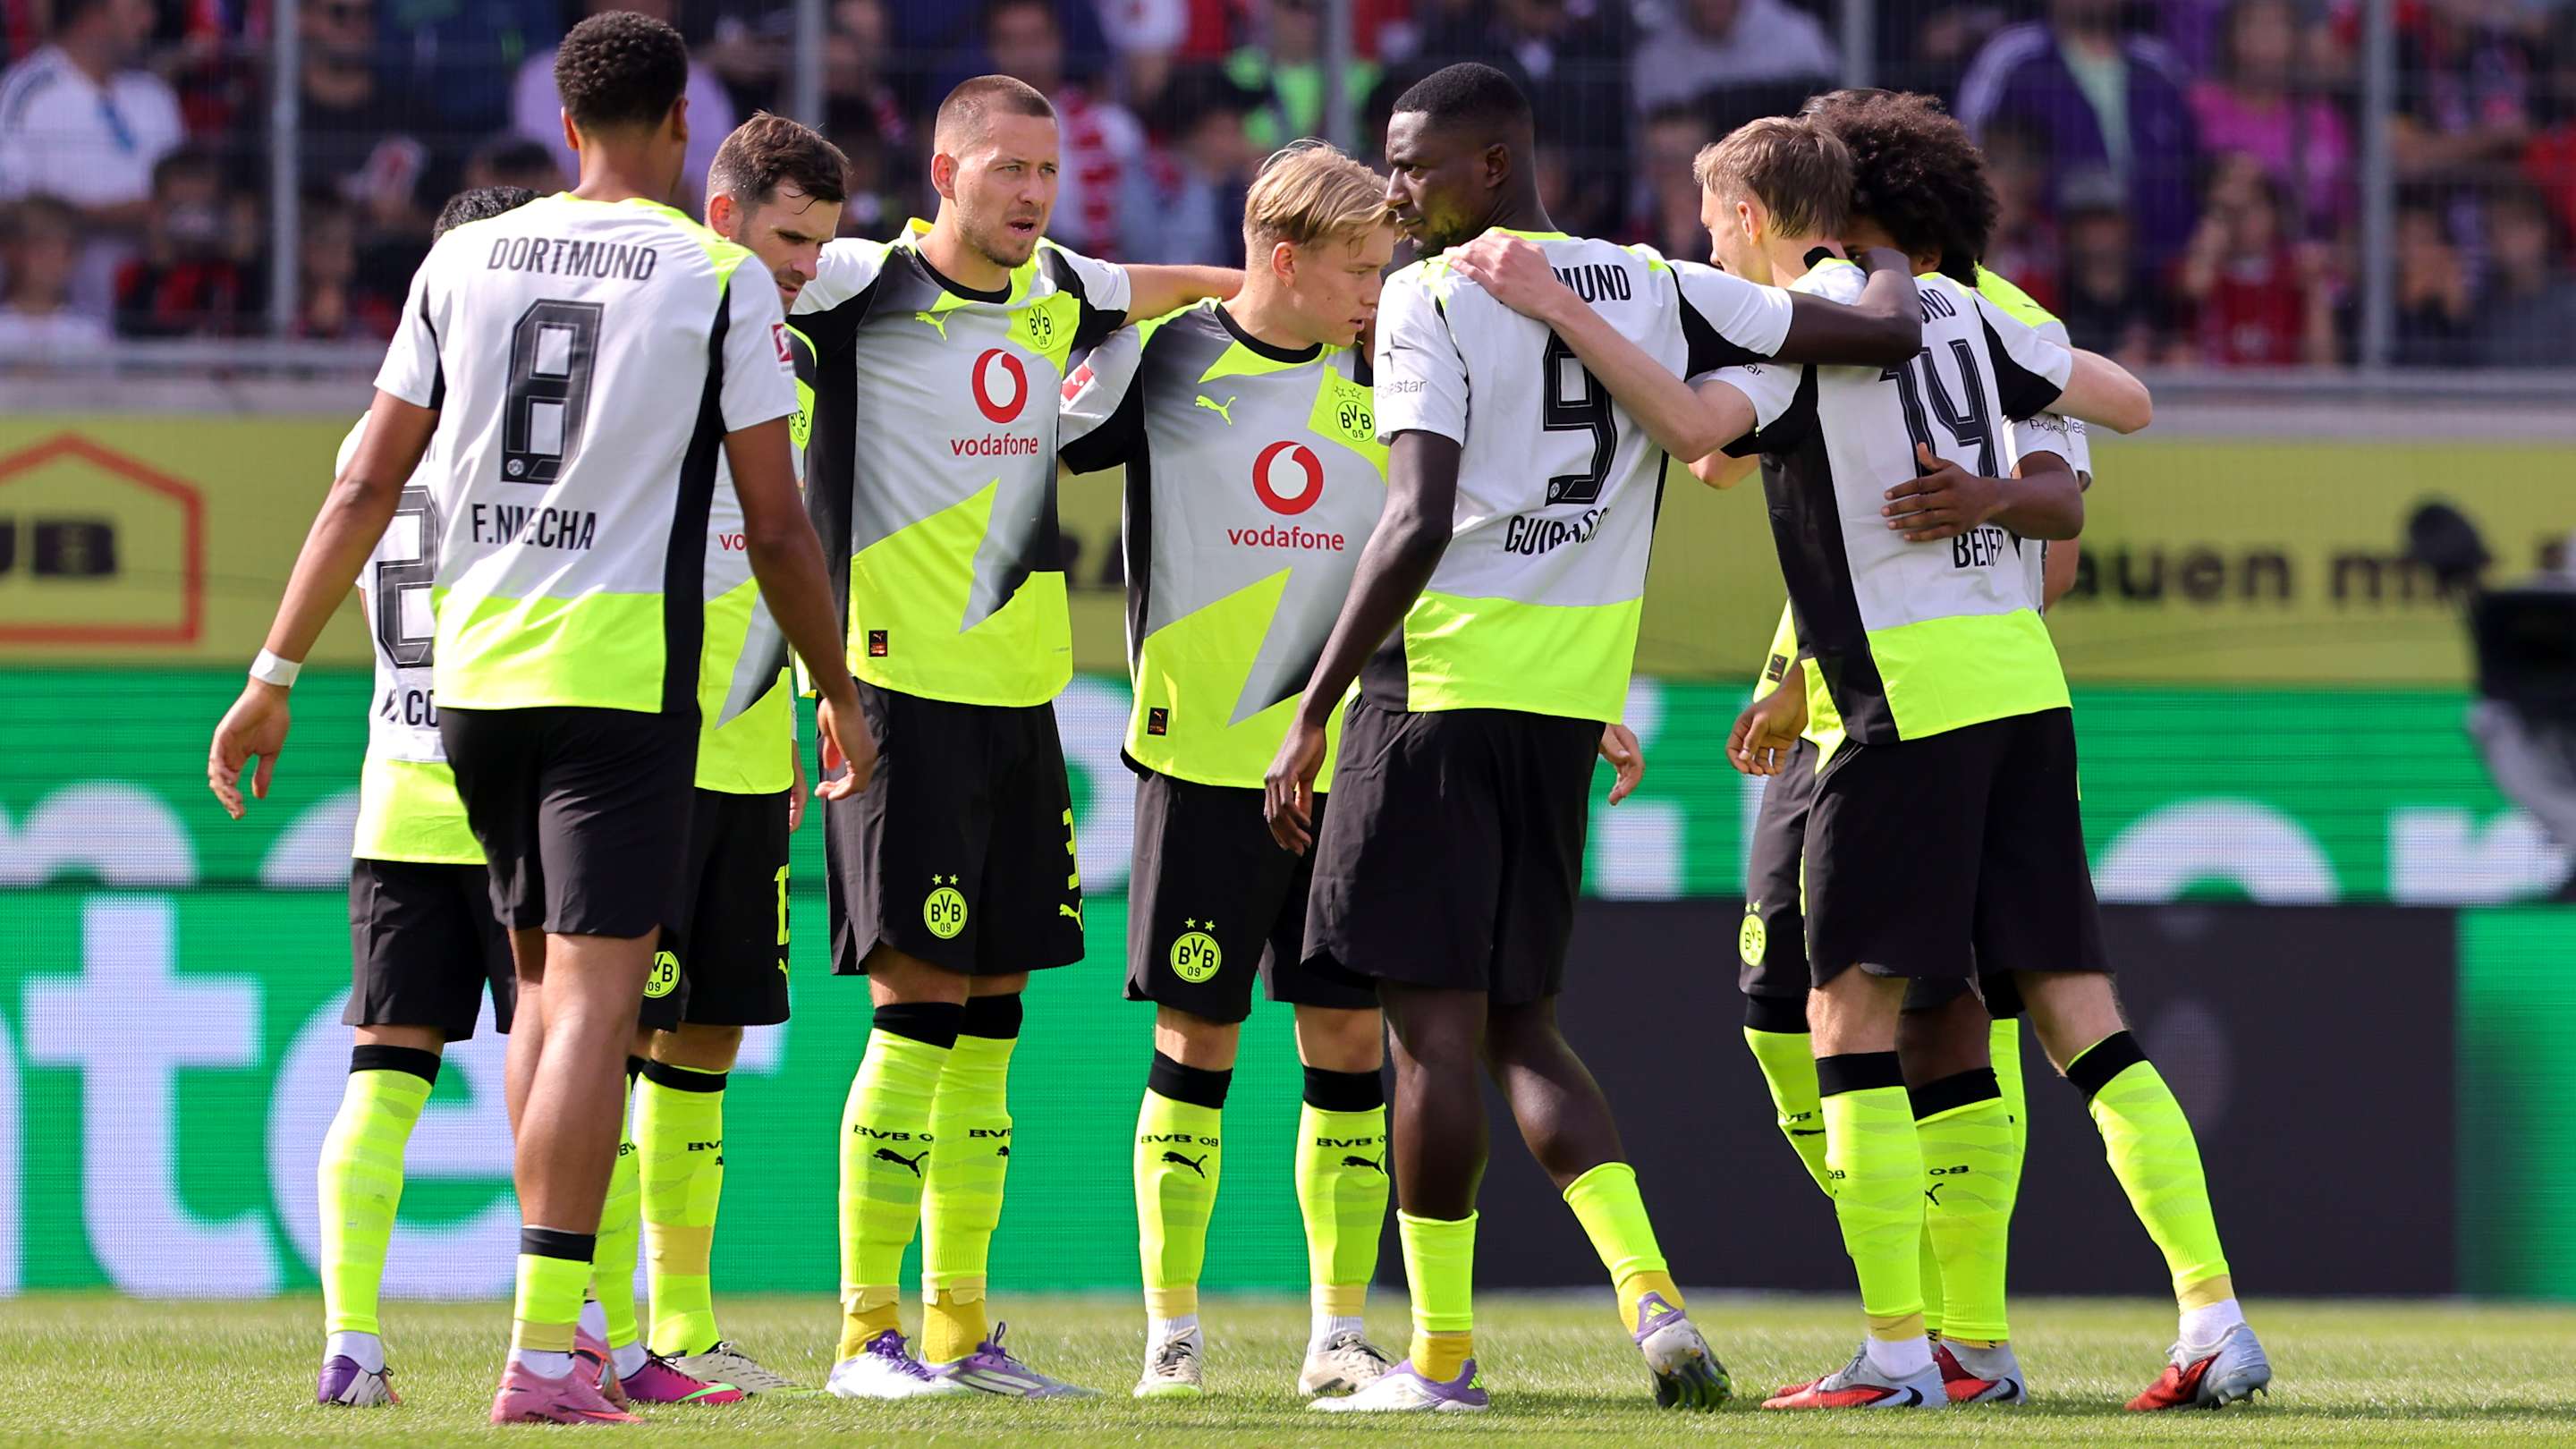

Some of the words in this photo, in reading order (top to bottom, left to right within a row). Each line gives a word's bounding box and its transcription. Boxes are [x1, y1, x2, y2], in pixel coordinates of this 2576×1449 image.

[487, 237, 657, 281] DORTMUND
[1030, 308, 1052, 336] BVB
[501, 298, 605, 484] 8
[1340, 403, 1372, 429] BVB
[1543, 328, 1619, 506] 9
[1879, 338, 2000, 480] 14
[950, 432, 1038, 456] vodafone
[1352, 429, 1365, 438] 09
[1226, 524, 1345, 551] vodafone
[377, 485, 439, 669] 2
[931, 894, 962, 922] BVB
[940, 922, 952, 933] 09
[1178, 937, 1216, 968] BVB
[1187, 966, 1201, 977] 09
[648, 981, 661, 992] 09
[854, 1124, 911, 1140] BVB
[1141, 1133, 1193, 1143] BVB
[1199, 1137, 1219, 1147] 09
[1317, 1137, 1372, 1148] BVB
[687, 1140, 722, 1151] BV
